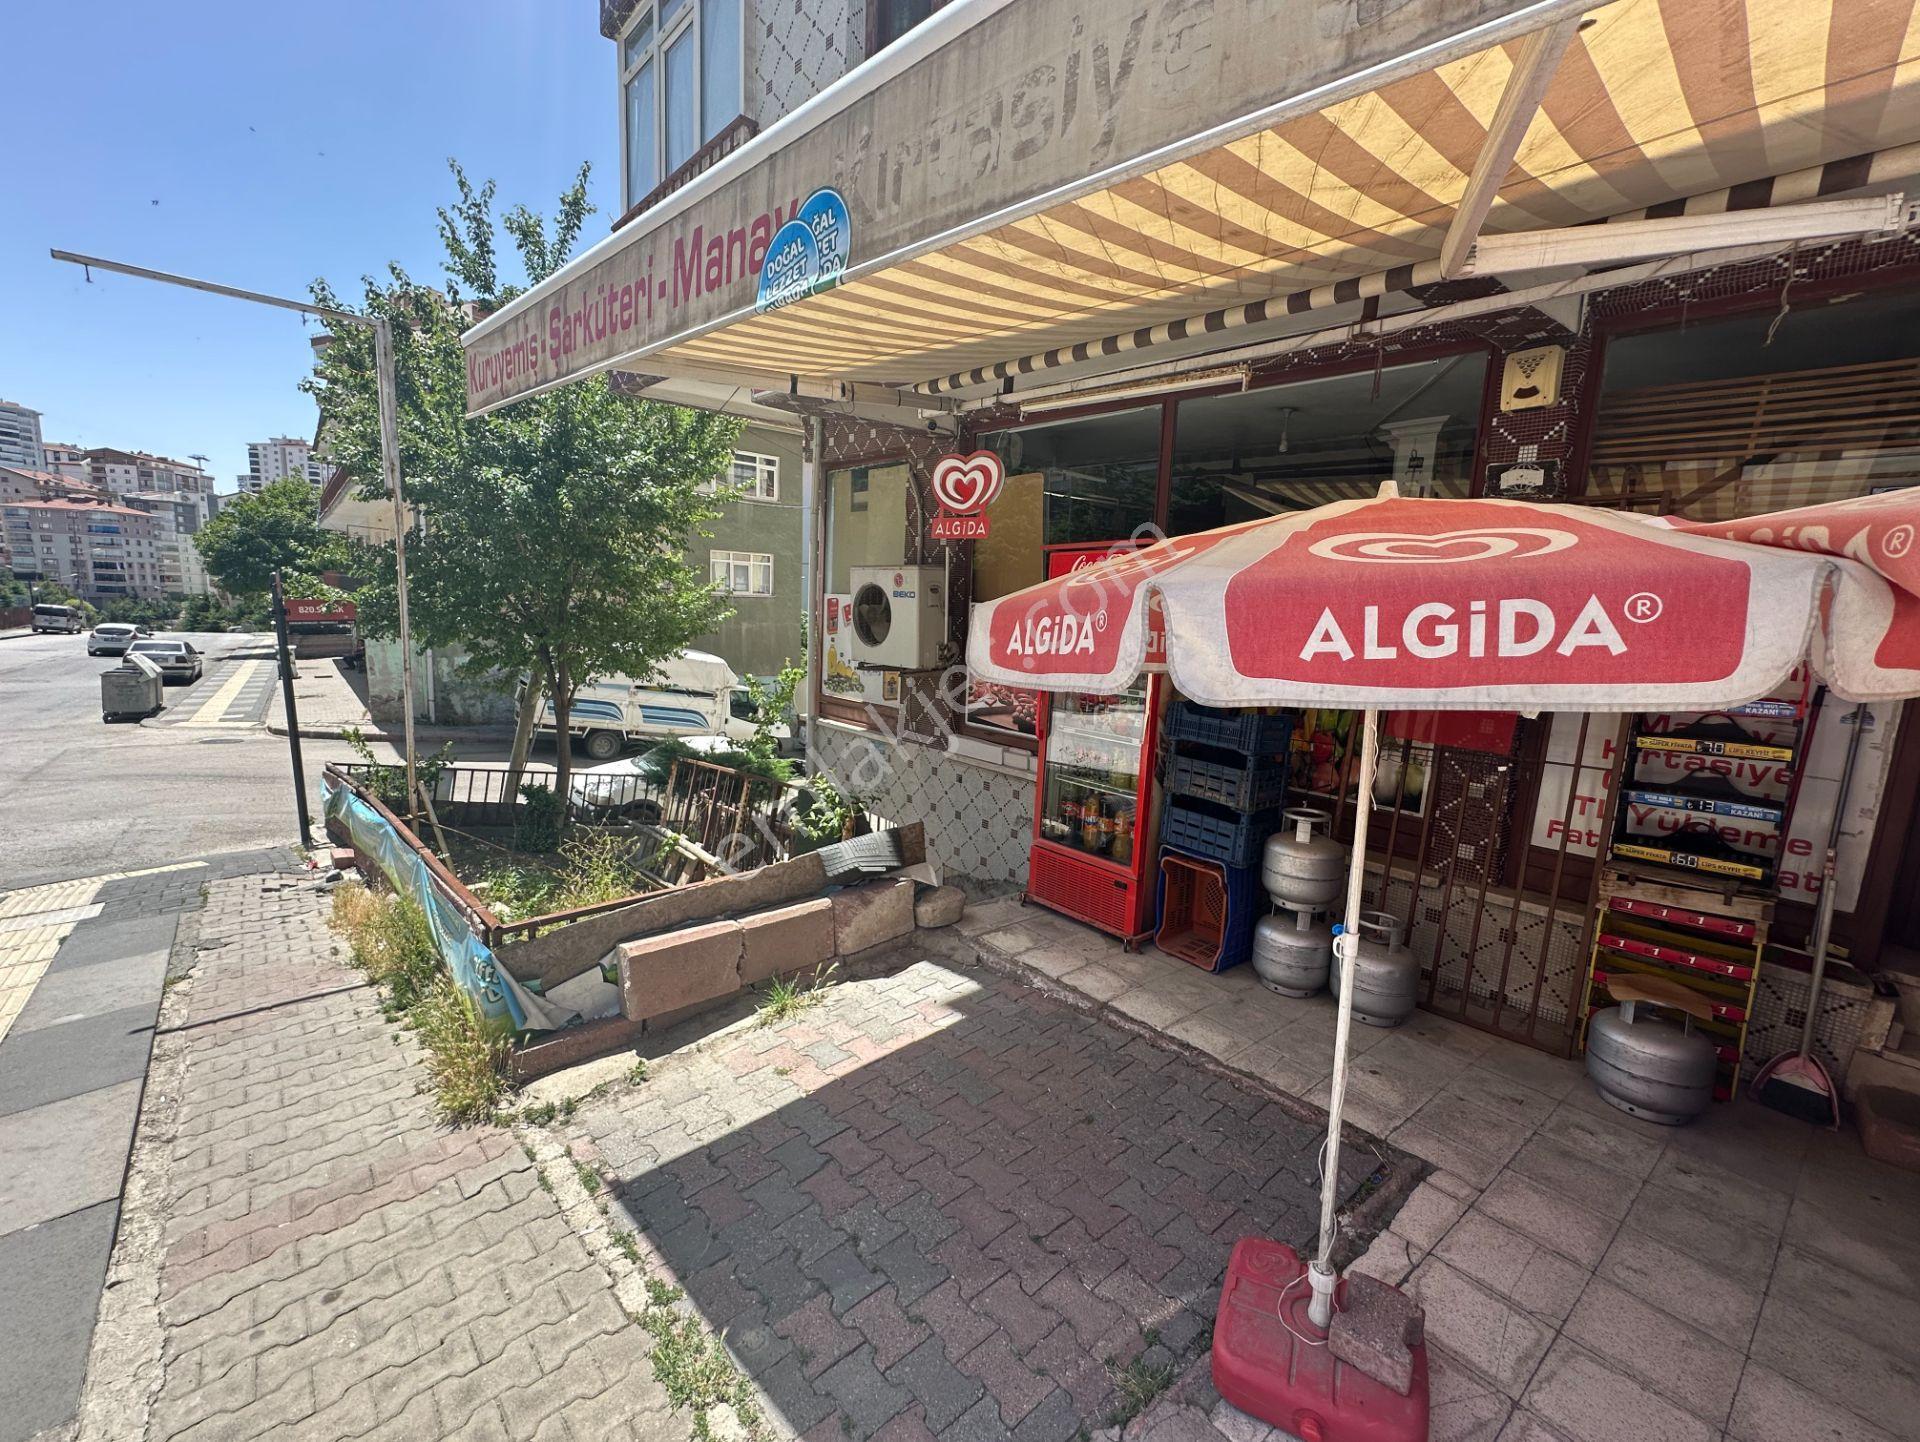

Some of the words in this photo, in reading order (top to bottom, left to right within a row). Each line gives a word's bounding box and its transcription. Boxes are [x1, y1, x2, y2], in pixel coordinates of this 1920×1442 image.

[812, 208, 836, 235] ĞAL
[765, 256, 807, 300] LEZZET
[767, 237, 805, 279] DOĞAL
[549, 255, 654, 369] Şarküteri
[1602, 739, 1793, 787] Krtasiye
